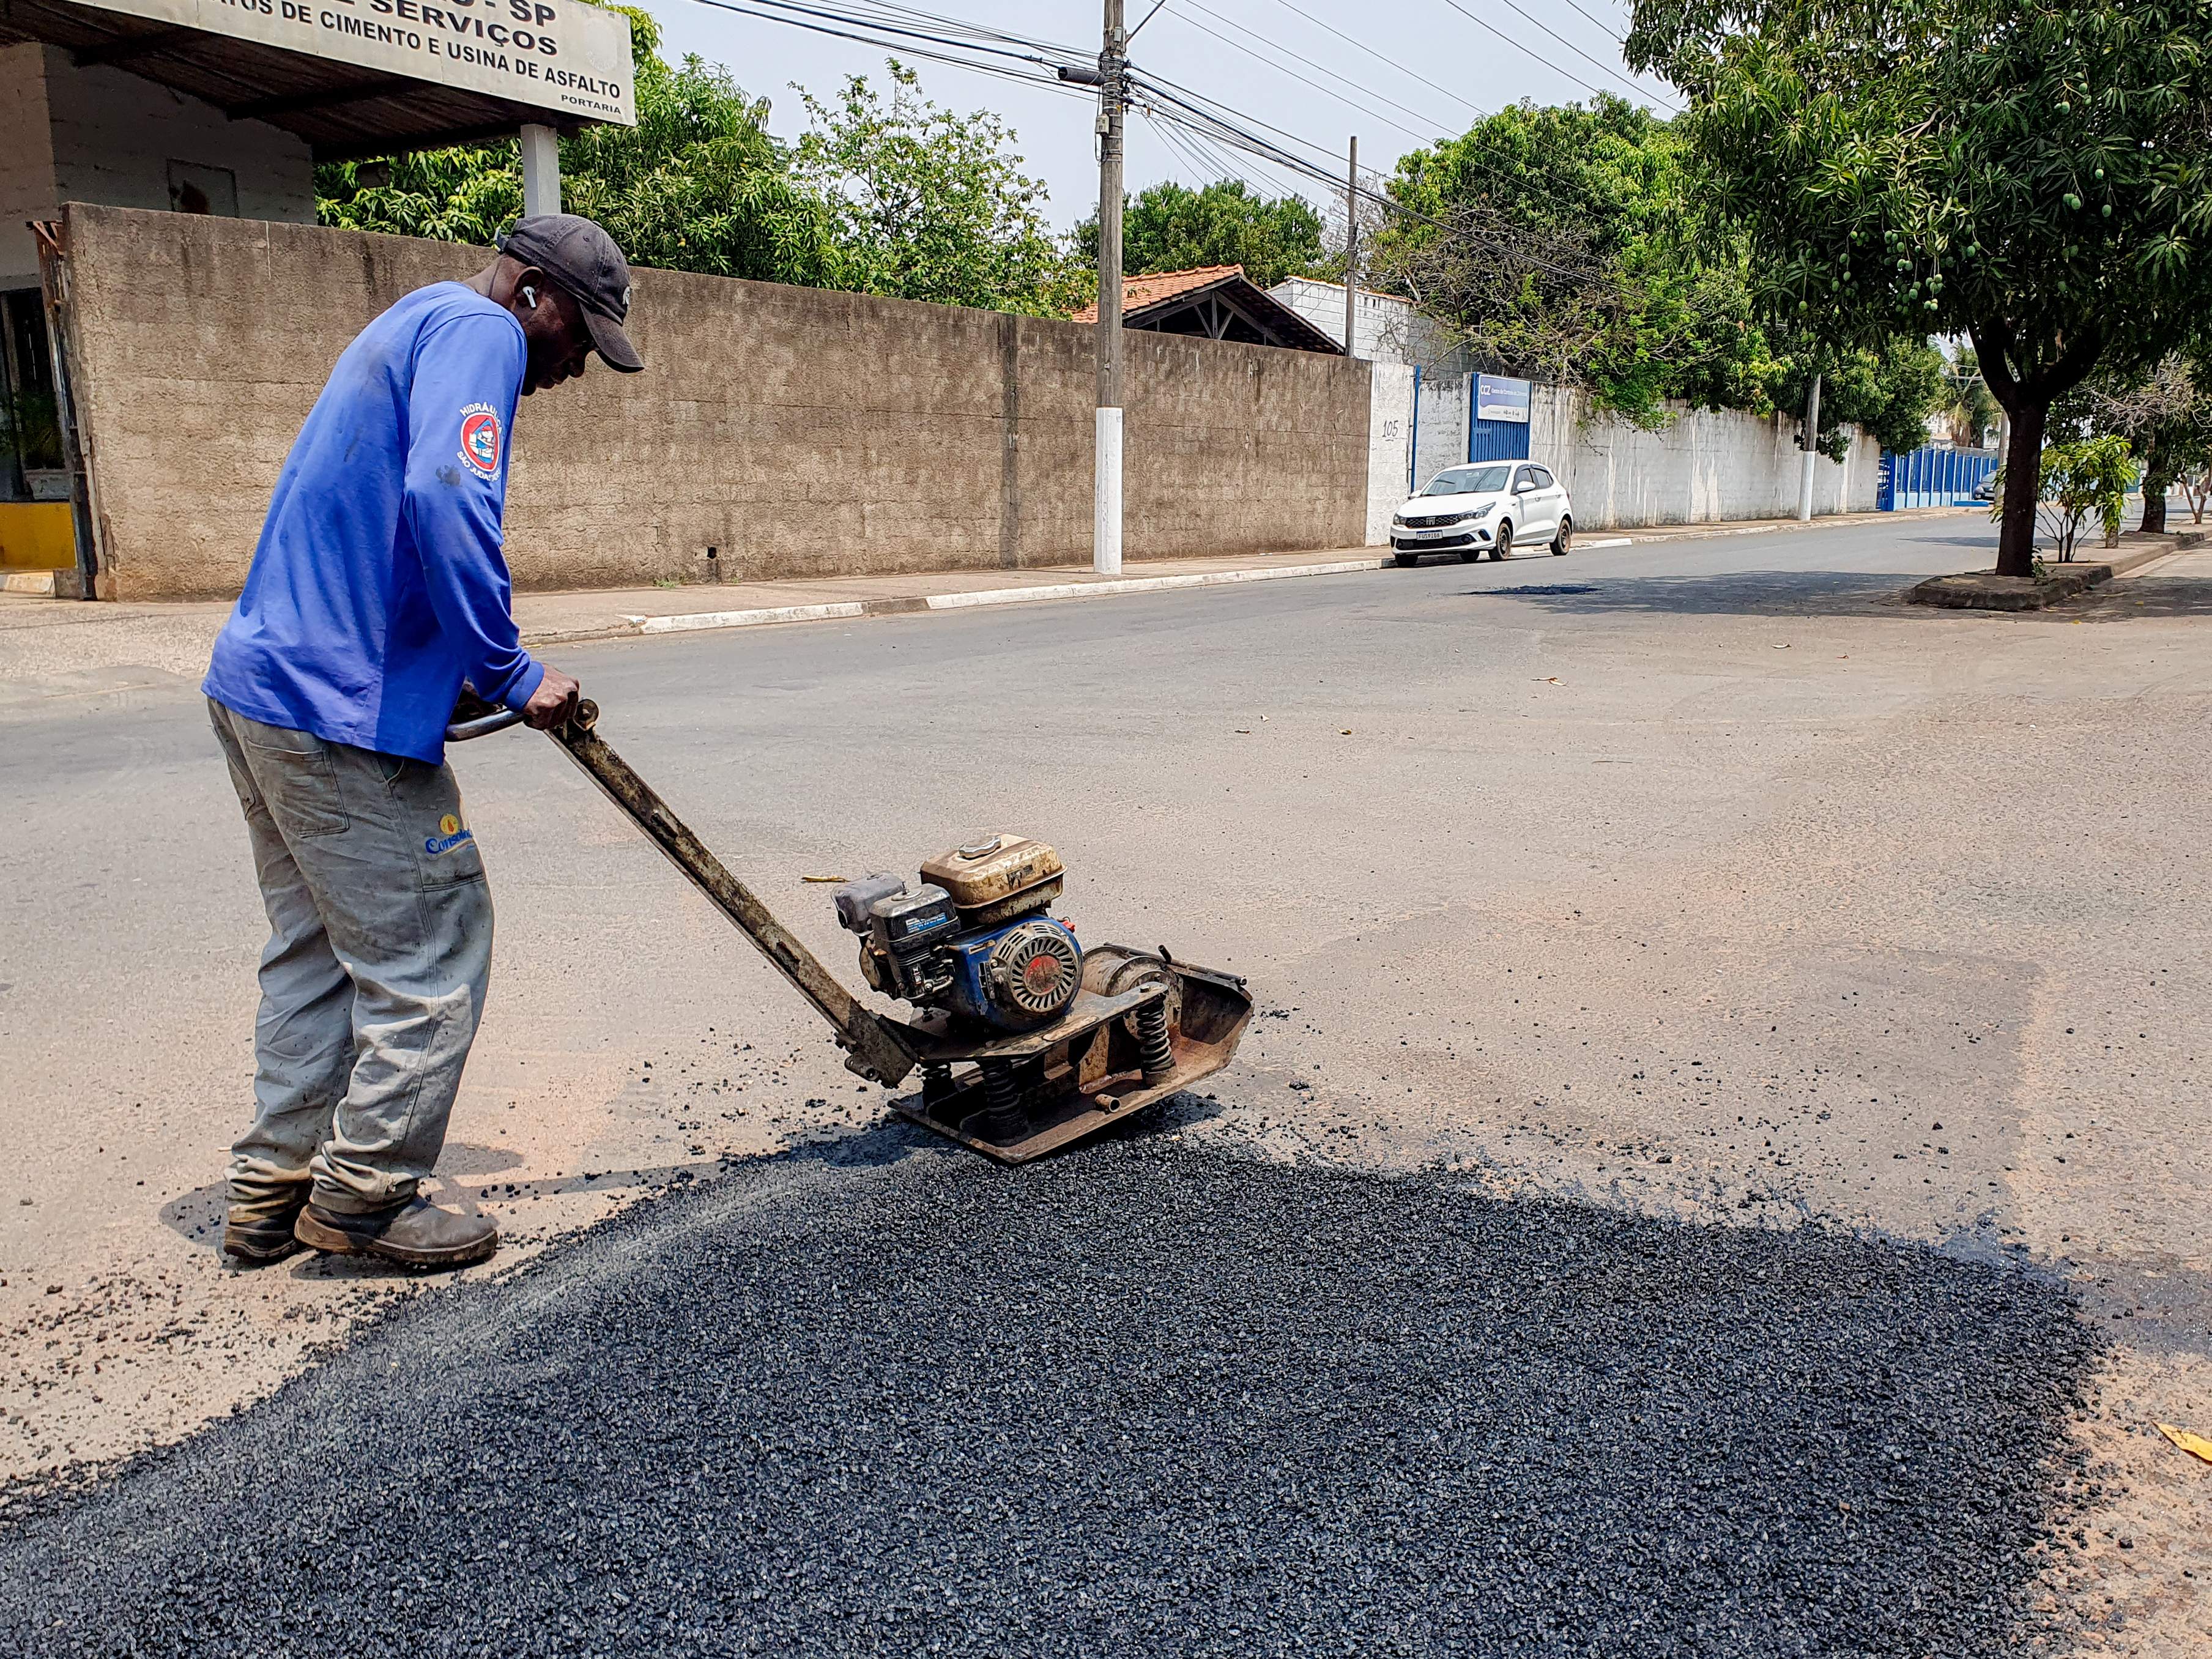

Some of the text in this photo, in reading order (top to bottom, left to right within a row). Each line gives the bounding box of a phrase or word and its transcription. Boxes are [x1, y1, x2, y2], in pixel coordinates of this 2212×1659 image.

[510, 0, 556, 27] SP
[369, 0, 557, 56] SERVIÇOS
[281, 1, 313, 24] DE
[321, 10, 421, 50] CIMENTO
[428, 38, 440, 55] E
[447, 42, 509, 72] USINA
[516, 58, 539, 79] DE
[545, 67, 620, 98] ASFALTO
[561, 94, 621, 114] PORTARIA
[1480, 385, 1491, 395] CCZ
[1382, 420, 1399, 437] 105
